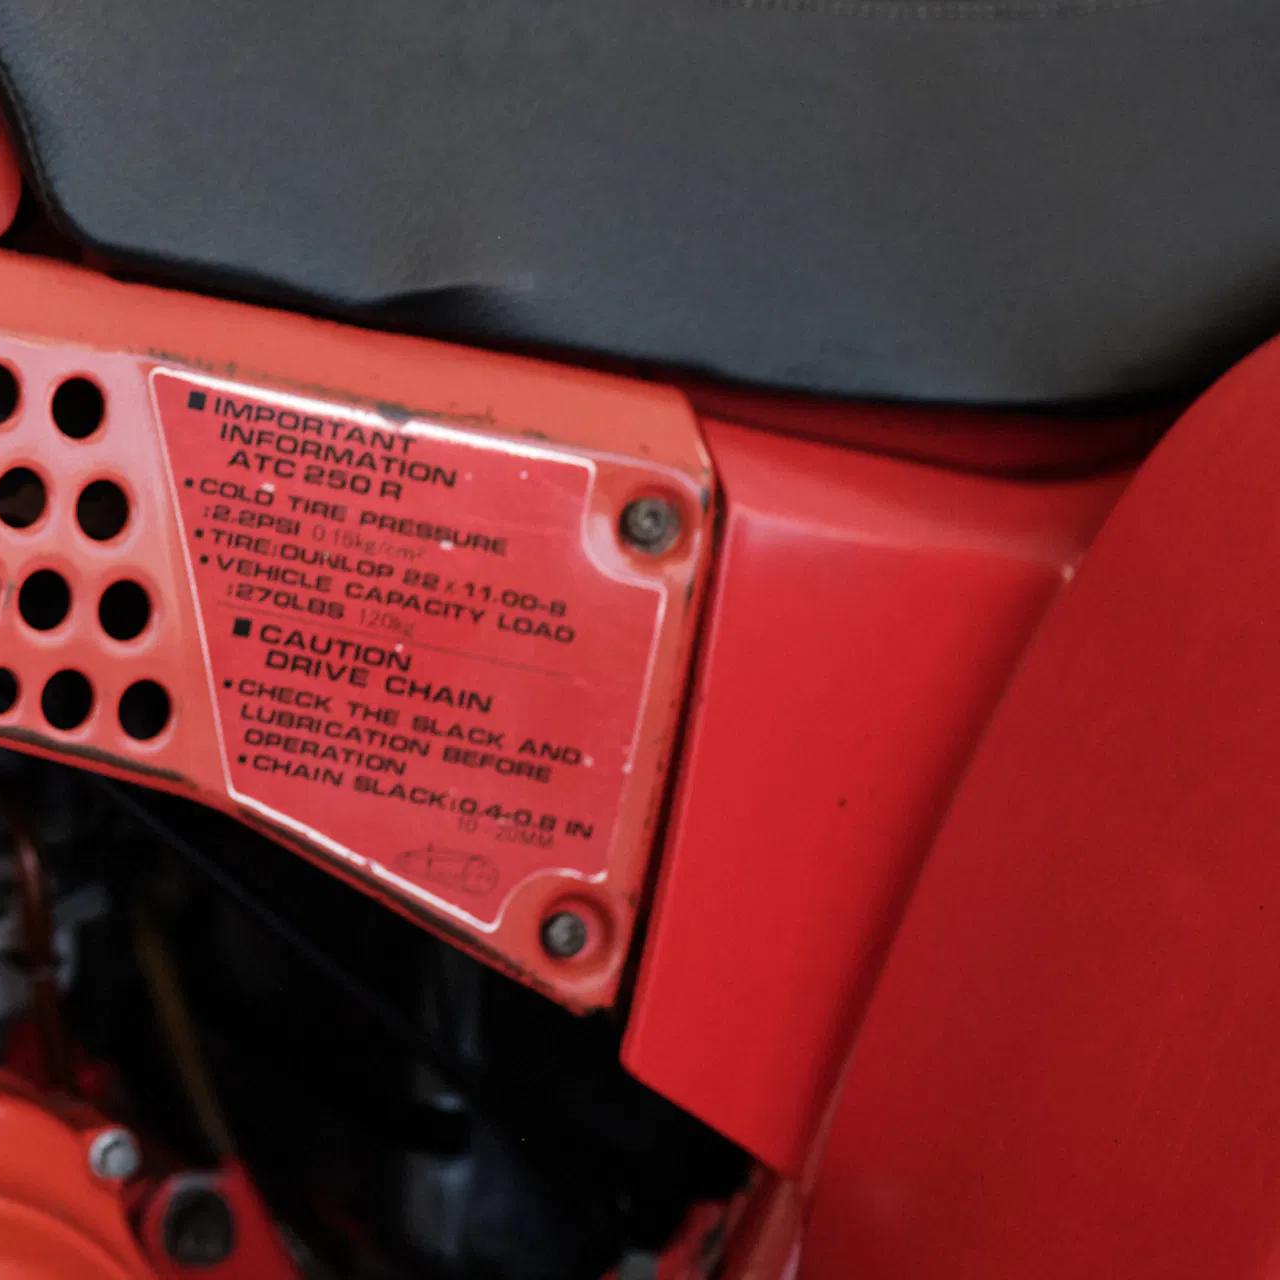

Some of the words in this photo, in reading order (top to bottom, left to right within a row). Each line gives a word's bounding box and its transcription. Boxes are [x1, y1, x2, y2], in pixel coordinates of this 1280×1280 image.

[214, 396, 417, 454] IMPORTANT
[220, 423, 457, 488] INFORMATION
[227, 450, 295, 482] ATC
[303, 467, 374, 496] 250
[379, 482, 404, 502] R
[200, 477, 275, 508] COLD
[288, 494, 347, 522] TIRE
[360, 510, 509, 557] PRESSURE
[215, 554, 333, 594] VEHICLE
[345, 582, 485, 625] CAPACITY
[497, 612, 576, 644] LOAD
[402, 569, 441, 592] 22
[259, 622, 413, 672] CAUTION
[264, 649, 369, 688] DRIVE
[385, 674, 494, 713] CHAIN
[237, 678, 333, 713] CHECK
[346, 700, 399, 727] THE
[411, 714, 506, 749] SLACK
[517, 737, 582, 767] AND
[240, 703, 431, 758] LUBRICATION
[442, 743, 553, 784] BEFORE
[243, 727, 407, 777] OPERATION
[251, 753, 343, 787] CHAIN
[564, 819, 595, 841] IN
